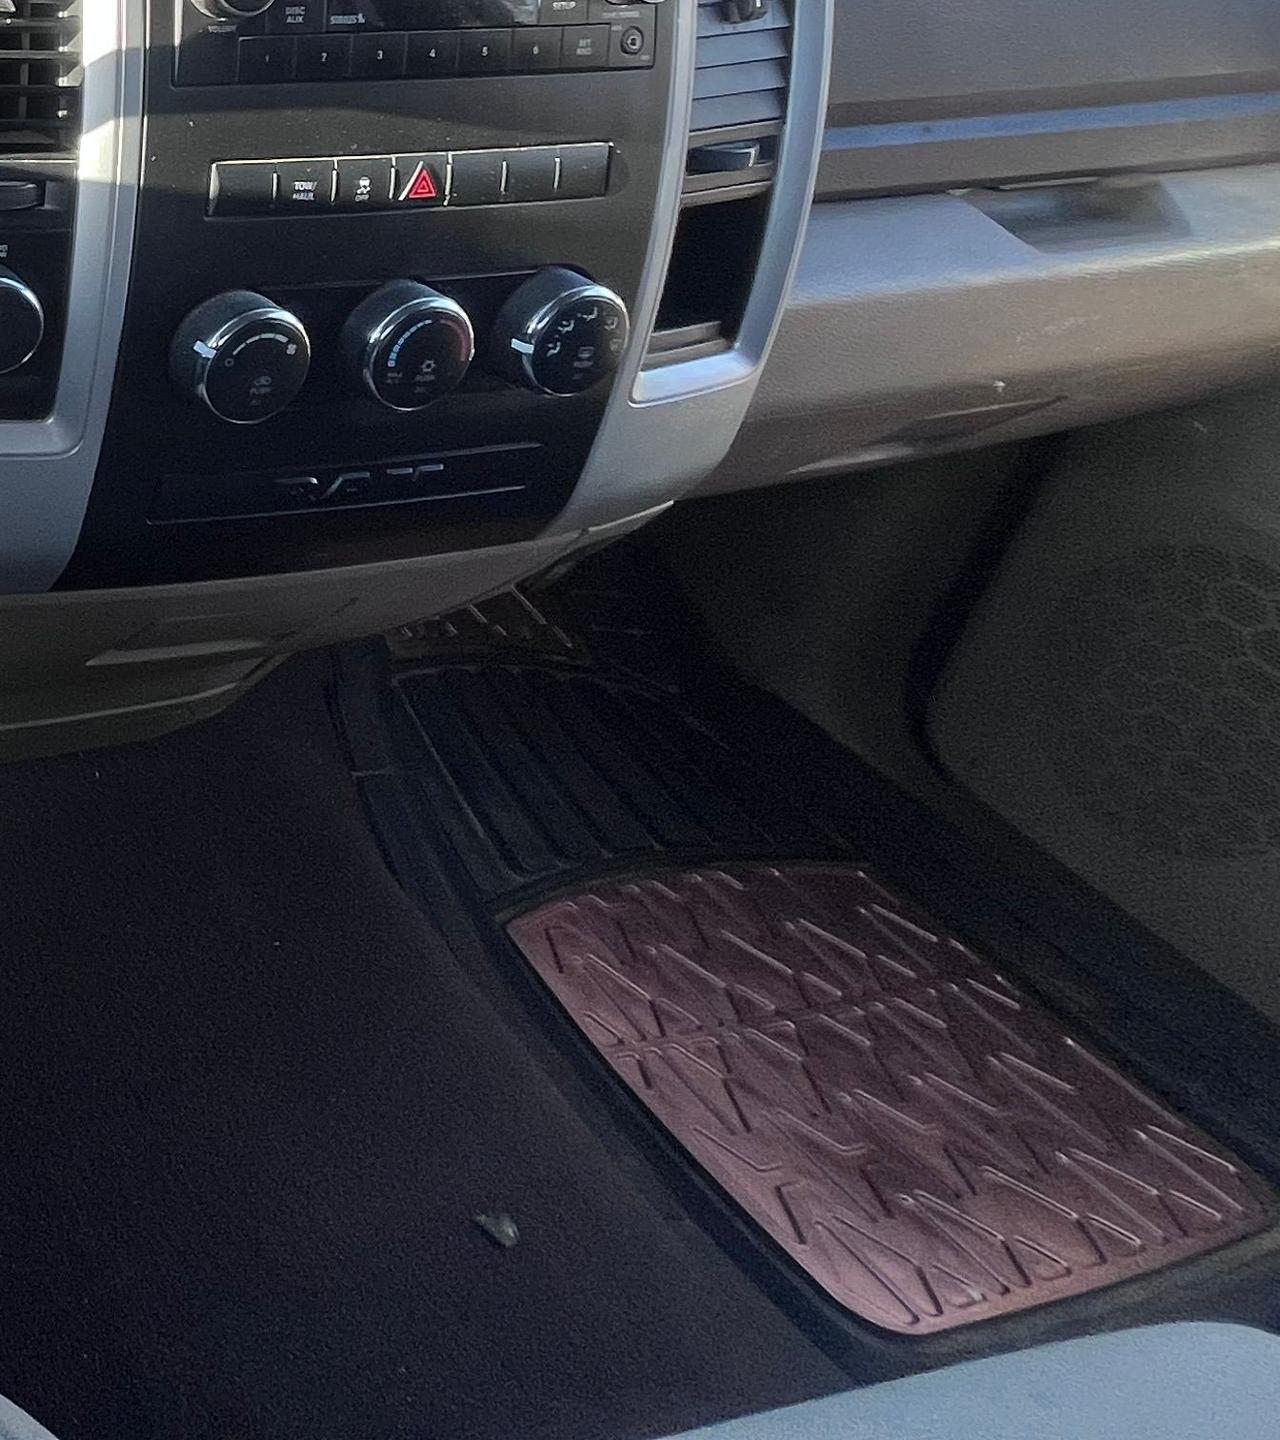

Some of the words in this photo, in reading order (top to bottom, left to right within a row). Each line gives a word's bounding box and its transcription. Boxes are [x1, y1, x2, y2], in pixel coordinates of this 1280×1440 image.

[377, 51, 383, 60] 3
[429, 49, 435, 58] 4
[482, 47, 488, 56] 5
